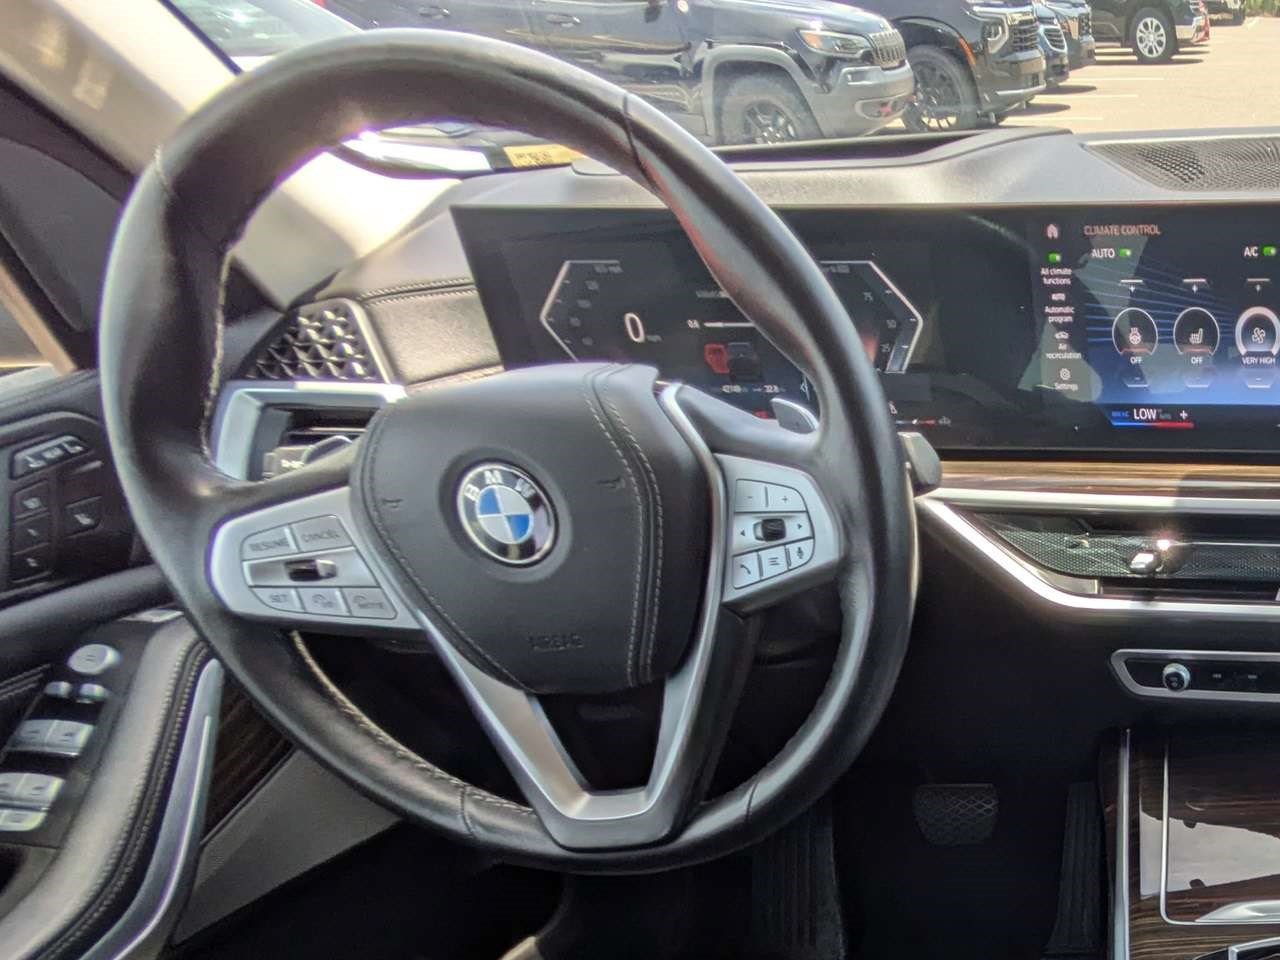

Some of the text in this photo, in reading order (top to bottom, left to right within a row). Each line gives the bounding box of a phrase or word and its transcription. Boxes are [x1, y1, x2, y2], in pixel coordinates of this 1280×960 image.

[1084, 224, 1161, 236] CLIMATE CONTROL
[1092, 248, 1116, 258] AUTO
[1244, 247, 1259, 257] A/C
[1050, 267, 1072, 276] climate
[1043, 277, 1071, 285] functions
[1045, 306, 1075, 314] Automatic
[624, 312, 645, 343] 0
[1242, 357, 1276, 365] VERY HIGH
[1133, 408, 1157, 420] LOW
[464, 470, 536, 501] BMW
